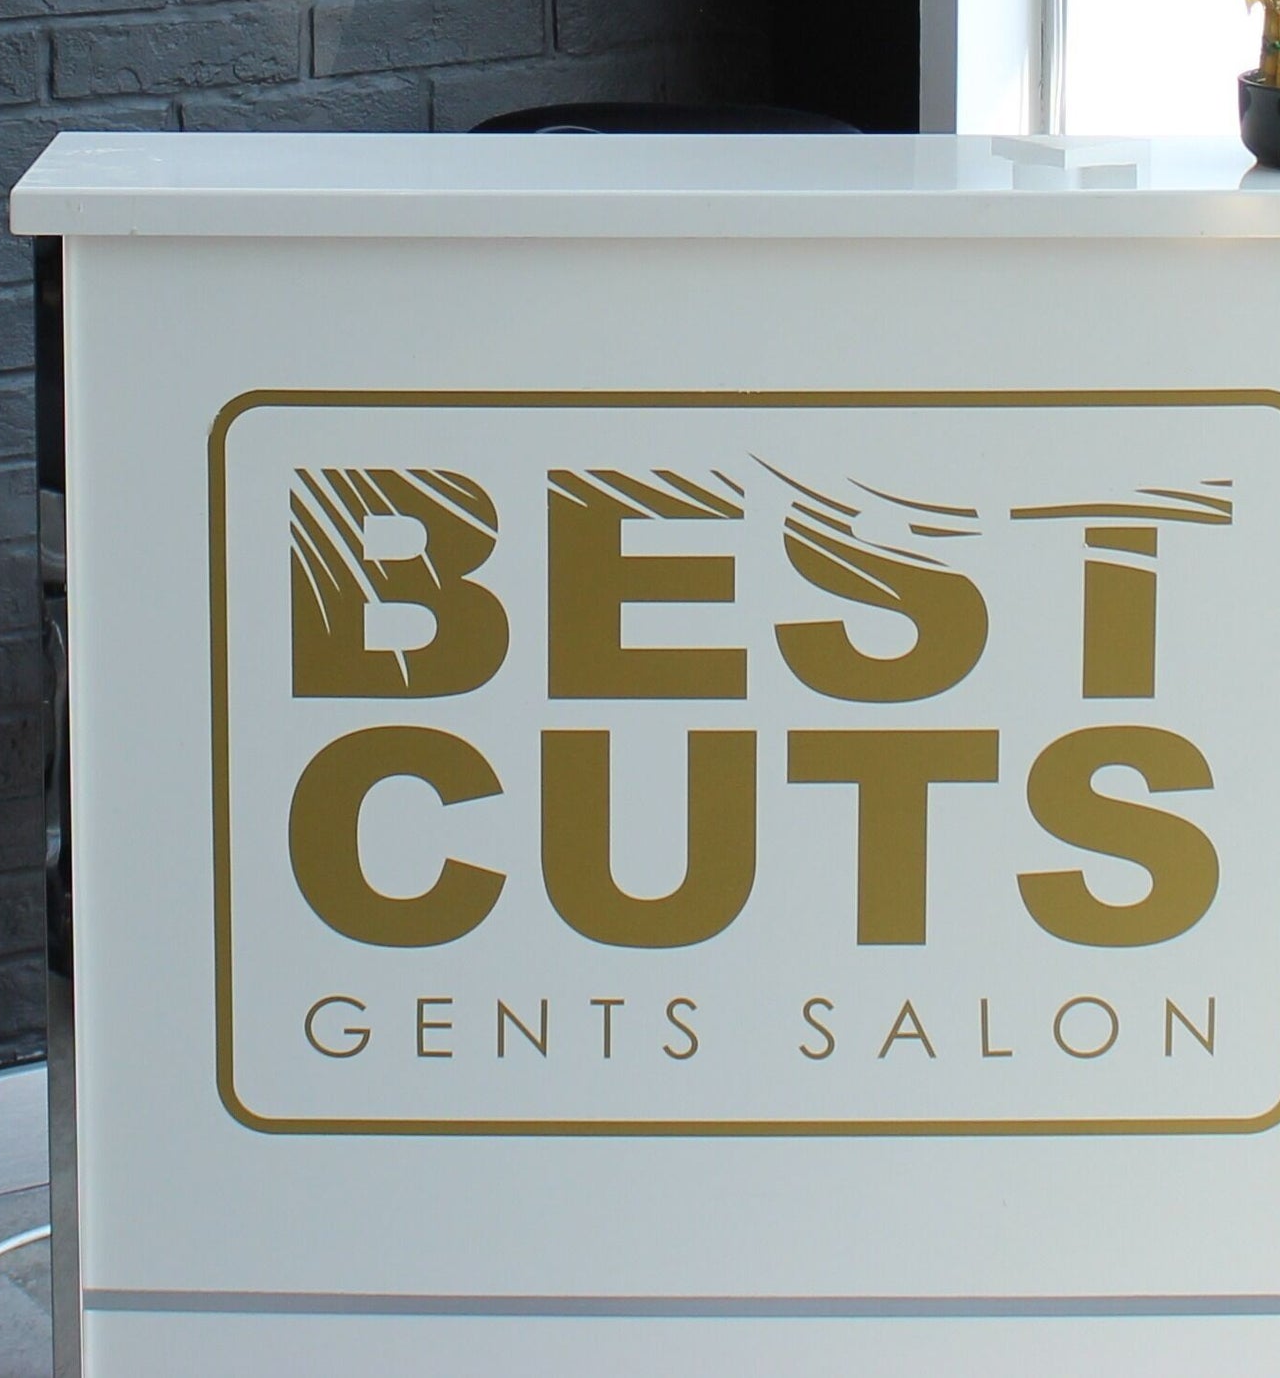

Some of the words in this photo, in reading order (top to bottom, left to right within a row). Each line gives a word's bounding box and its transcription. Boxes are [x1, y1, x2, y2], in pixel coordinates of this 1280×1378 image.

[290, 451, 1233, 703] BEST
[288, 725, 1220, 948] CUTS
[304, 995, 699, 1059] GENTS
[798, 995, 1216, 1059] SALON
